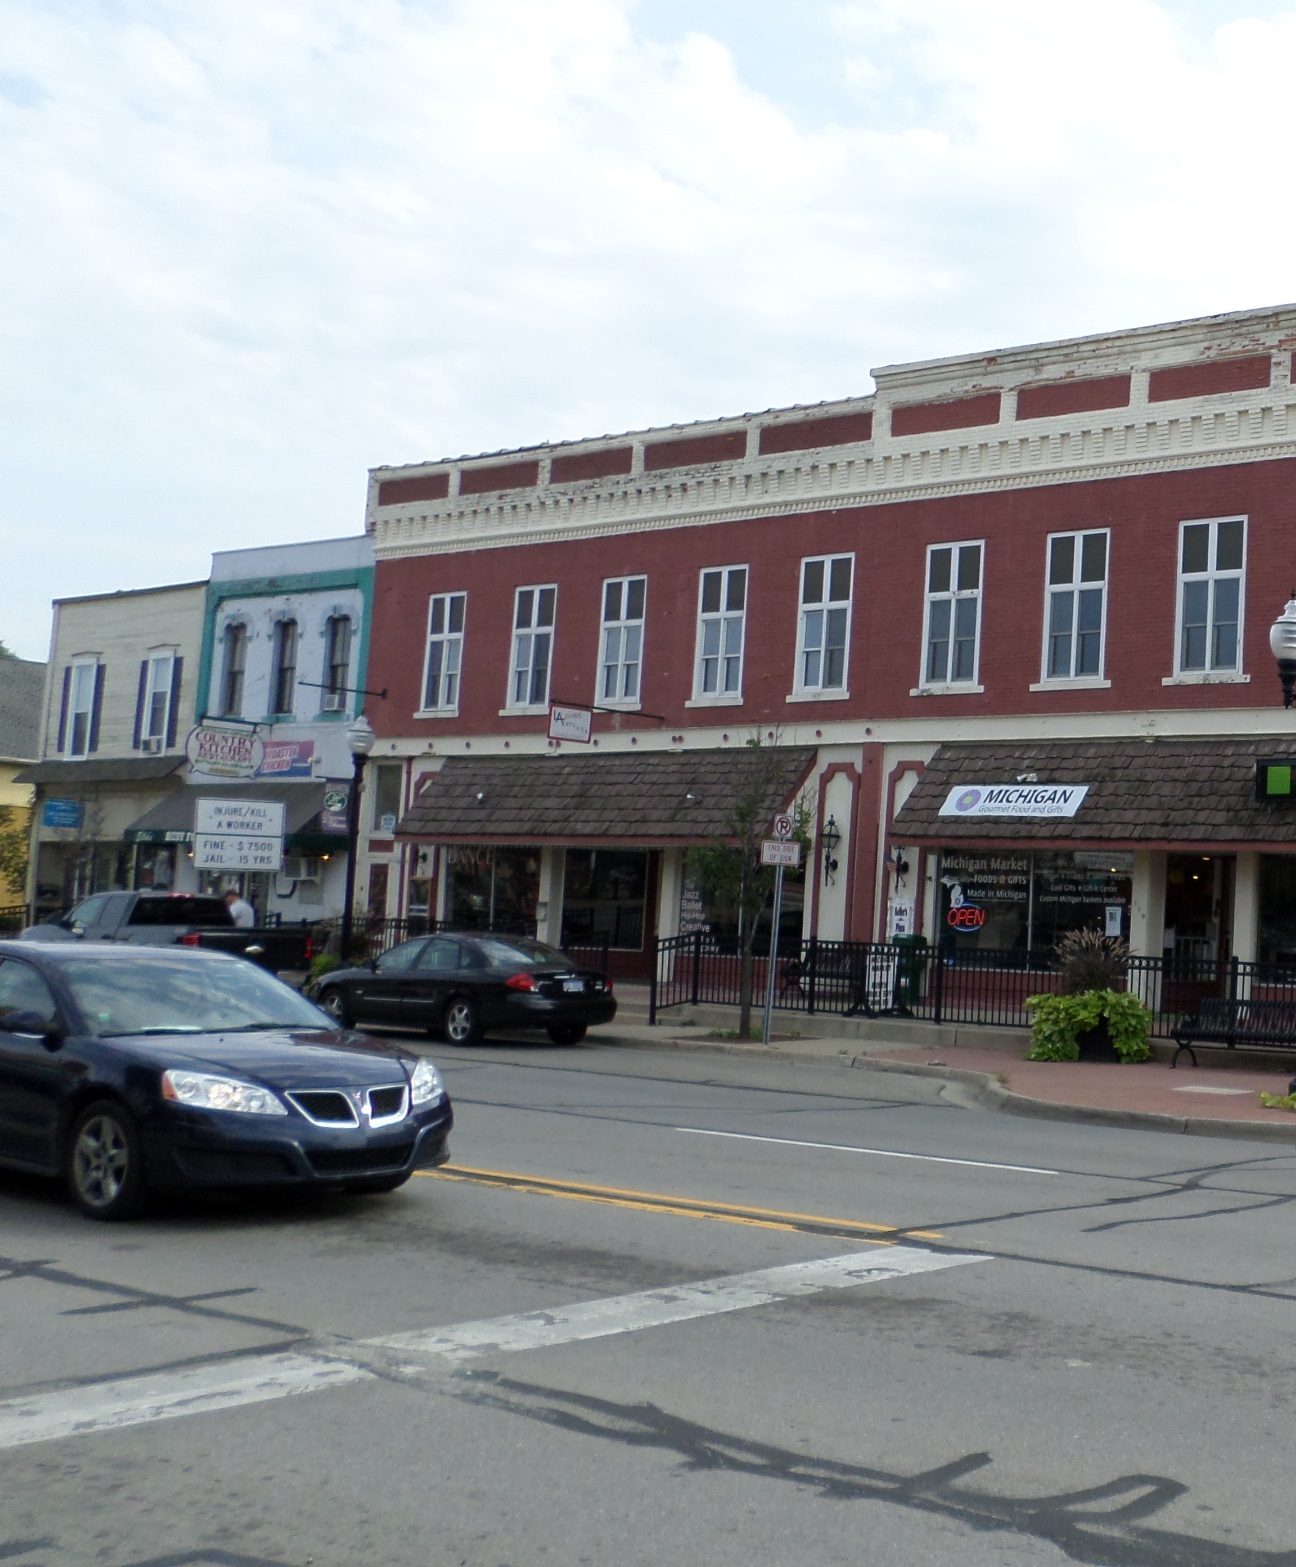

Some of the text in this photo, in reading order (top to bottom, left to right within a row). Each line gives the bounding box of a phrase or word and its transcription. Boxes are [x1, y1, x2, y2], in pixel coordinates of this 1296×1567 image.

[196, 732, 256, 748] COUNTRY
[199, 742, 252, 758] KITCHEN
[983, 789, 1074, 804] MICHIGAN
[213, 805, 267, 818] INJURE/KILL
[978, 804, 1063, 814] Gourmet Food and Gifts
[216, 821, 263, 830] A WORKER
[203, 840, 226, 850] FINE
[203, 854, 225, 864] JAIL
[941, 856, 987, 872] Michigan
[990, 858, 1027, 870] Market
[974, 874, 997, 884] FOODS
[1007, 876, 1027, 885] GIFTS
[682, 890, 699, 899] Jazz
[967, 889, 986, 898] Made
[996, 890, 1027, 901] Michigan
[681, 901, 702, 911] Ballet
[947, 909, 986, 926] OPEN
[680, 921, 710, 933] Creative
